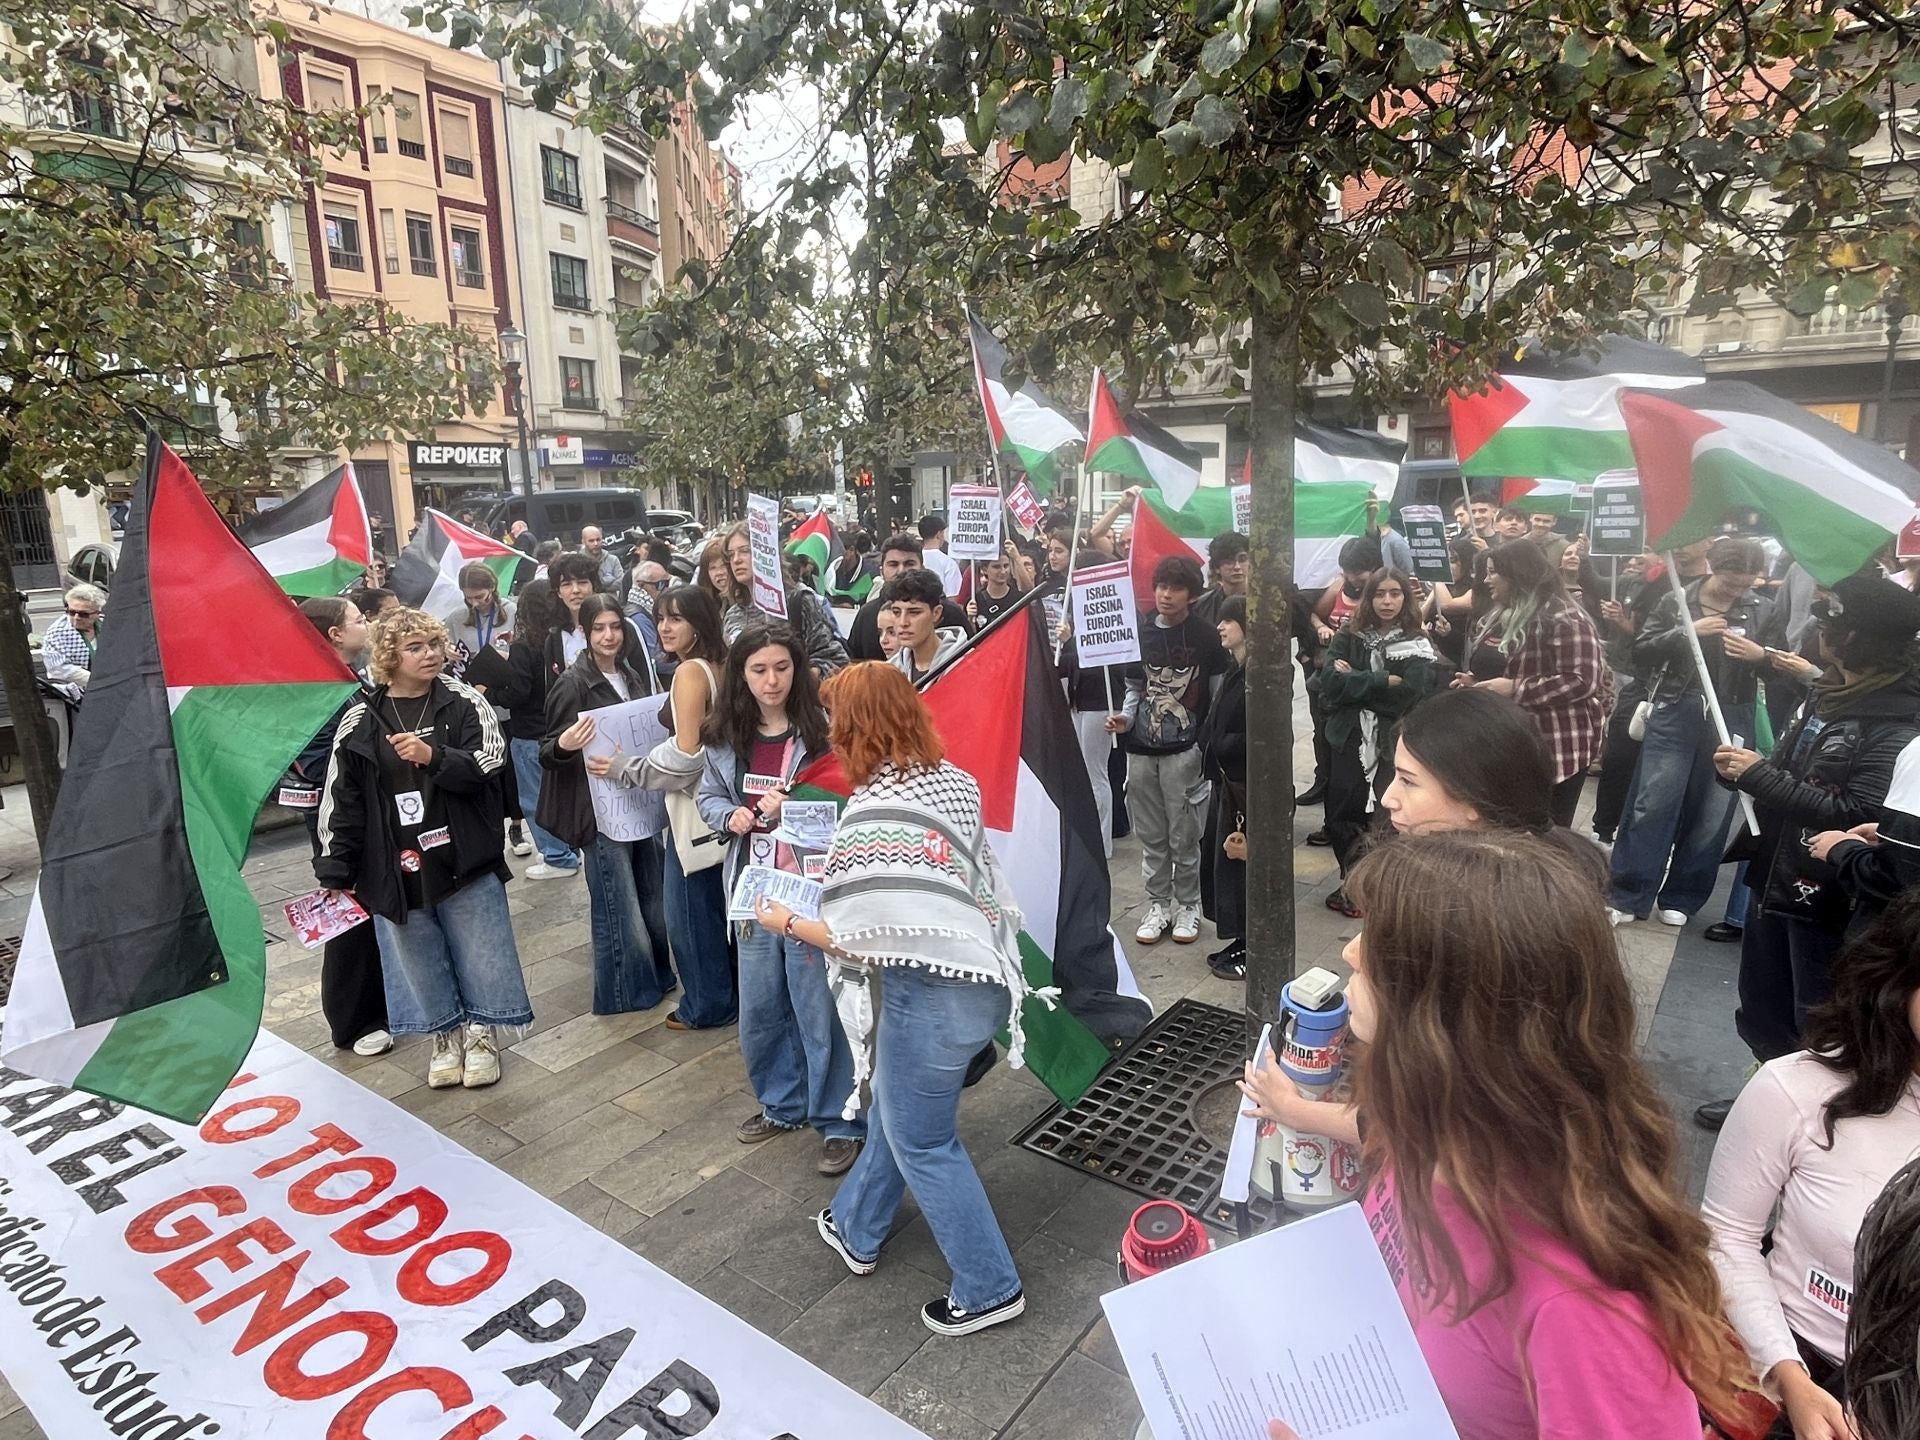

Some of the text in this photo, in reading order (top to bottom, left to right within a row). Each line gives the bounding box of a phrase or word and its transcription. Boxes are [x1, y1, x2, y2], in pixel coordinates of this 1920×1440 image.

[416, 446, 502, 465] REPOKER
[960, 499, 987, 510] ISRAEL
[957, 510, 991, 521] ASESINA
[957, 522, 989, 533] EUROPA
[951, 533, 995, 545] PATROCINA
[1085, 583, 1118, 601] ISRAEL
[1083, 598, 1124, 617] ASESINA
[1086, 613, 1124, 631] EUROPA
[1080, 627, 1134, 647] PATROCINA
[252, 1121, 512, 1307] TODO
[461, 1278, 799, 1440] PAR
[33, 1295, 106, 1348] de
